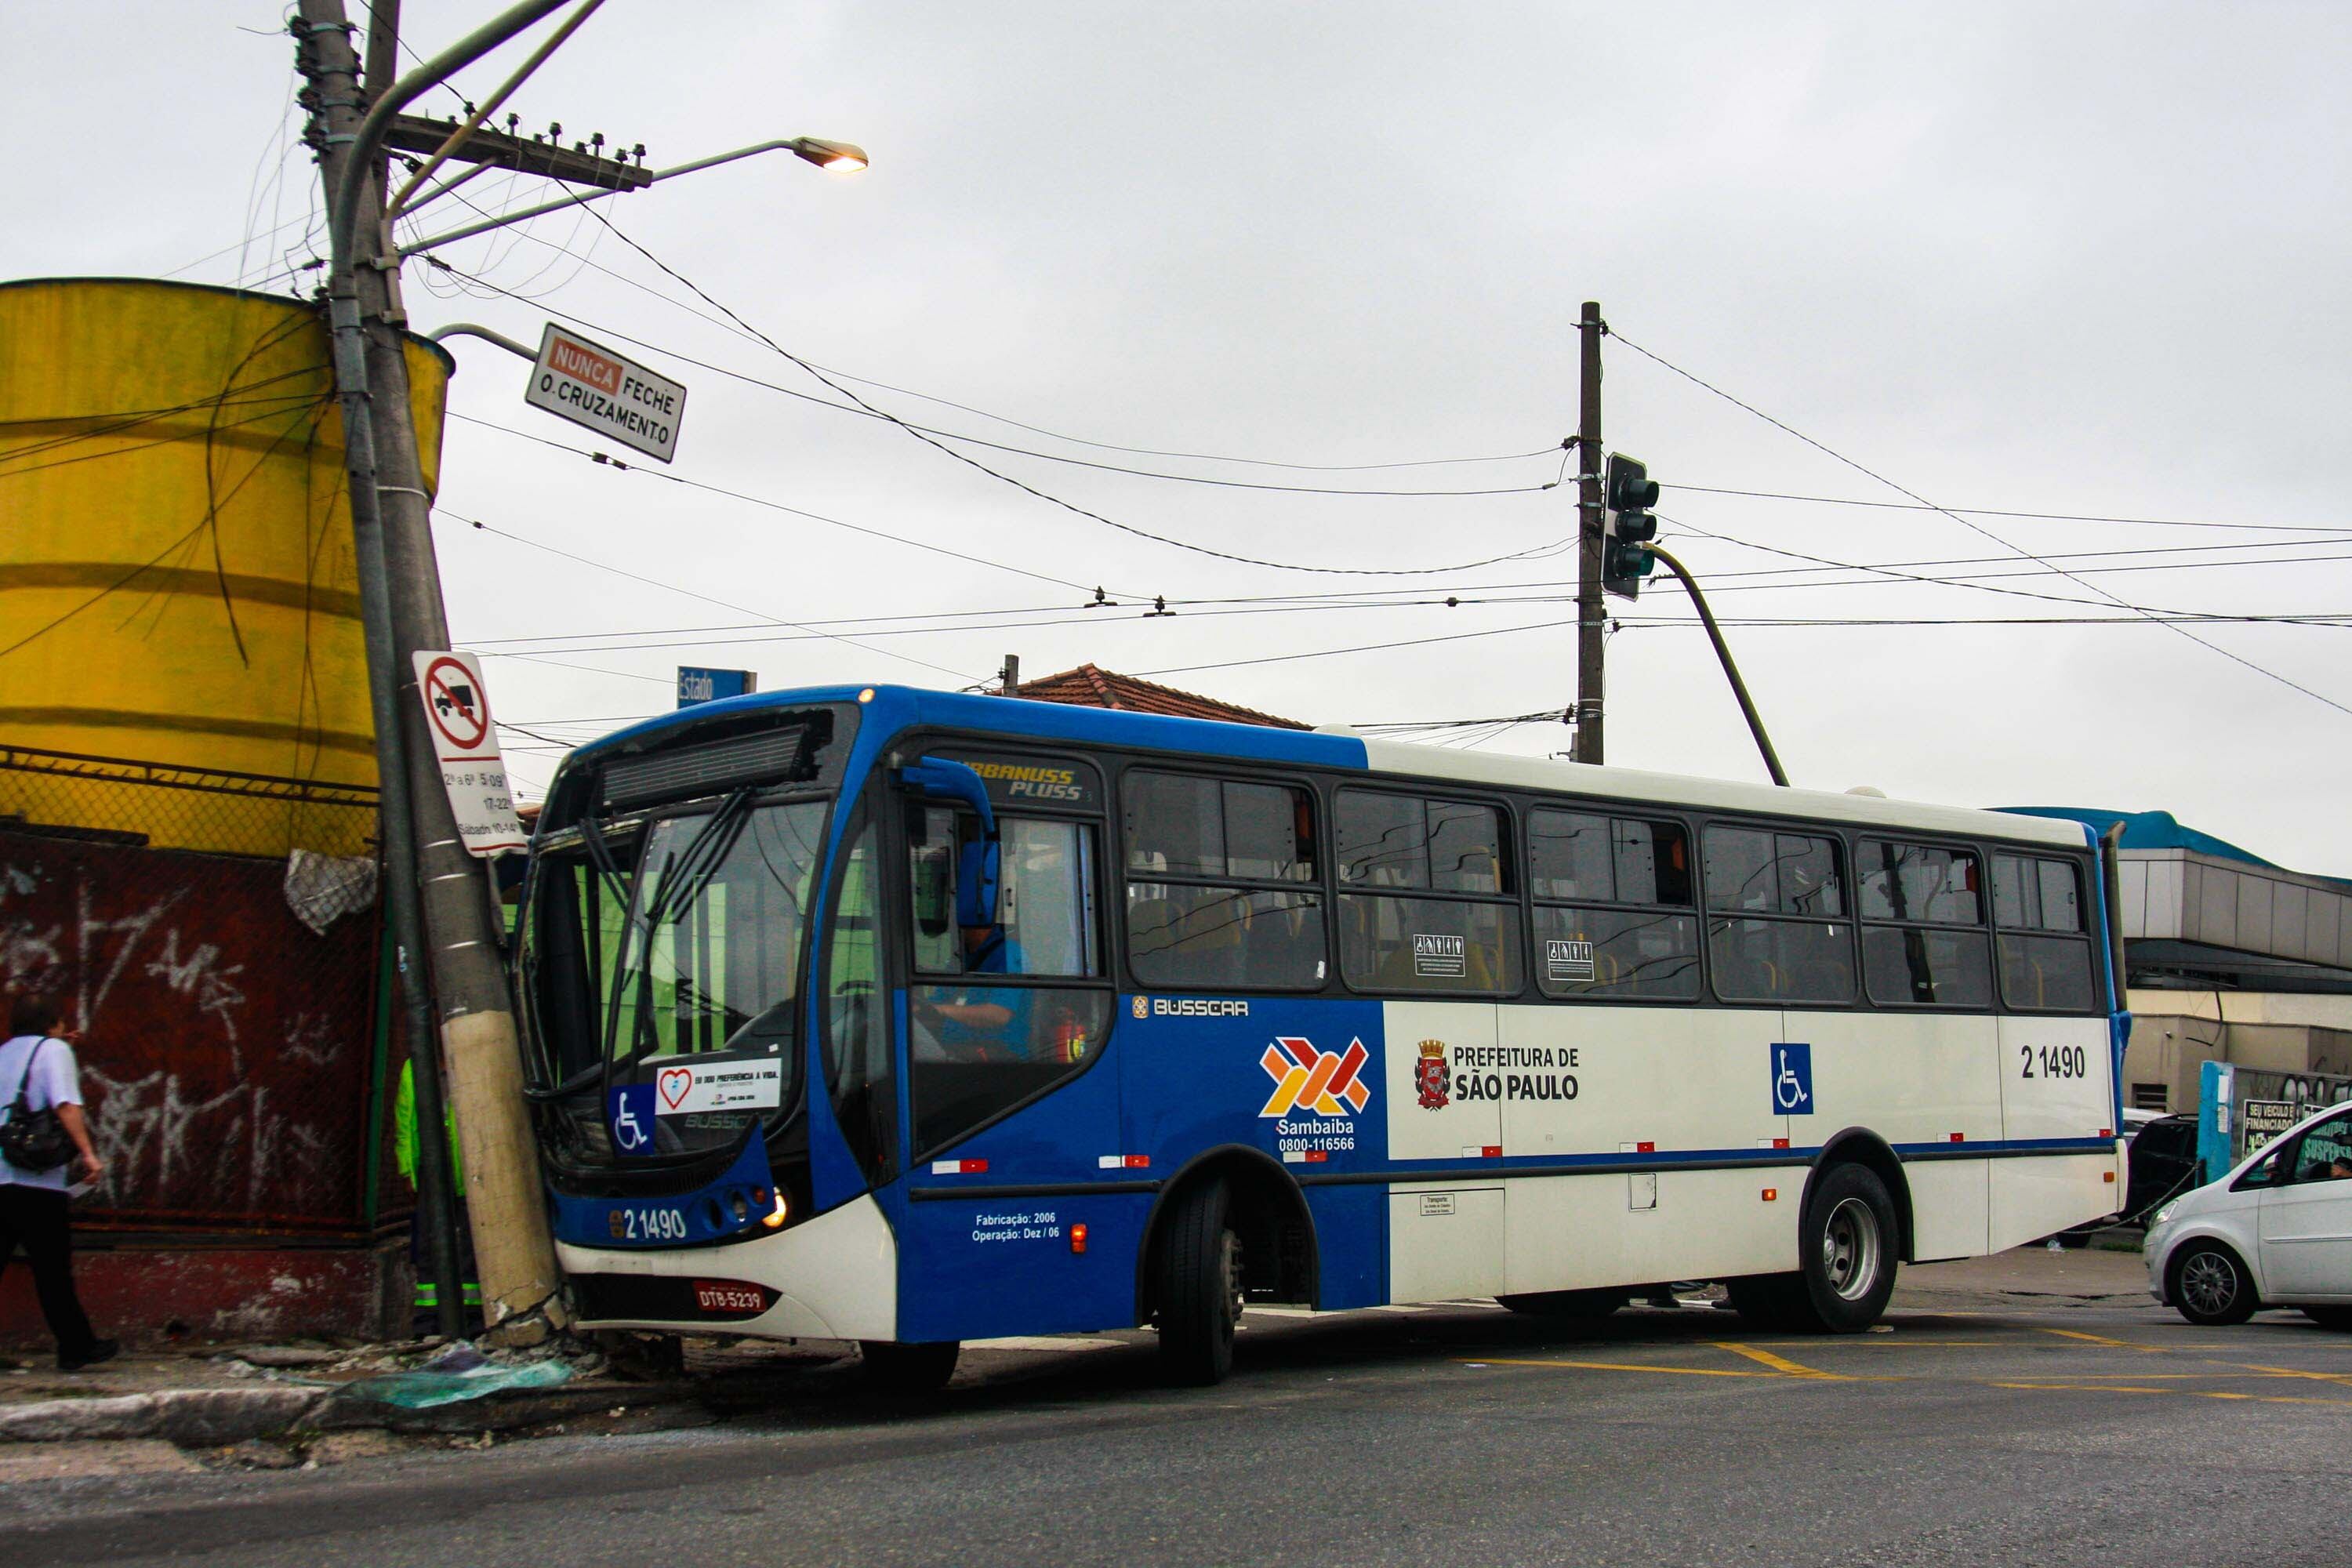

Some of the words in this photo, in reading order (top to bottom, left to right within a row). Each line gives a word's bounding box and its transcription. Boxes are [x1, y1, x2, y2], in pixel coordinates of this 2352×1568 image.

[555, 344, 614, 389] NUNCA
[622, 376, 675, 416] FECHE
[557, 381, 669, 445] CRUZAMENTO
[1008, 781, 1083, 801] PLUSS
[1153, 999, 1249, 1016] BUSSCAR
[1454, 1046, 1553, 1068] PREFEITURA
[1557, 1047, 1579, 1067] DE
[1455, 1069, 1502, 1101] SÃO
[1507, 1074, 1579, 1101] PAULO
[1278, 1118, 1354, 1135] Sambaiba
[2245, 1117, 2293, 1131] FINANCIADO
[1279, 1137, 1355, 1152] 0800-116566
[976, 1214, 1032, 1227] Fabricação:
[1033, 1212, 1056, 1224] 2006
[972, 1229, 1022, 1243] Operação:
[1023, 1228, 1041, 1239] Dez
[1048, 1226, 1060, 1238] 06
